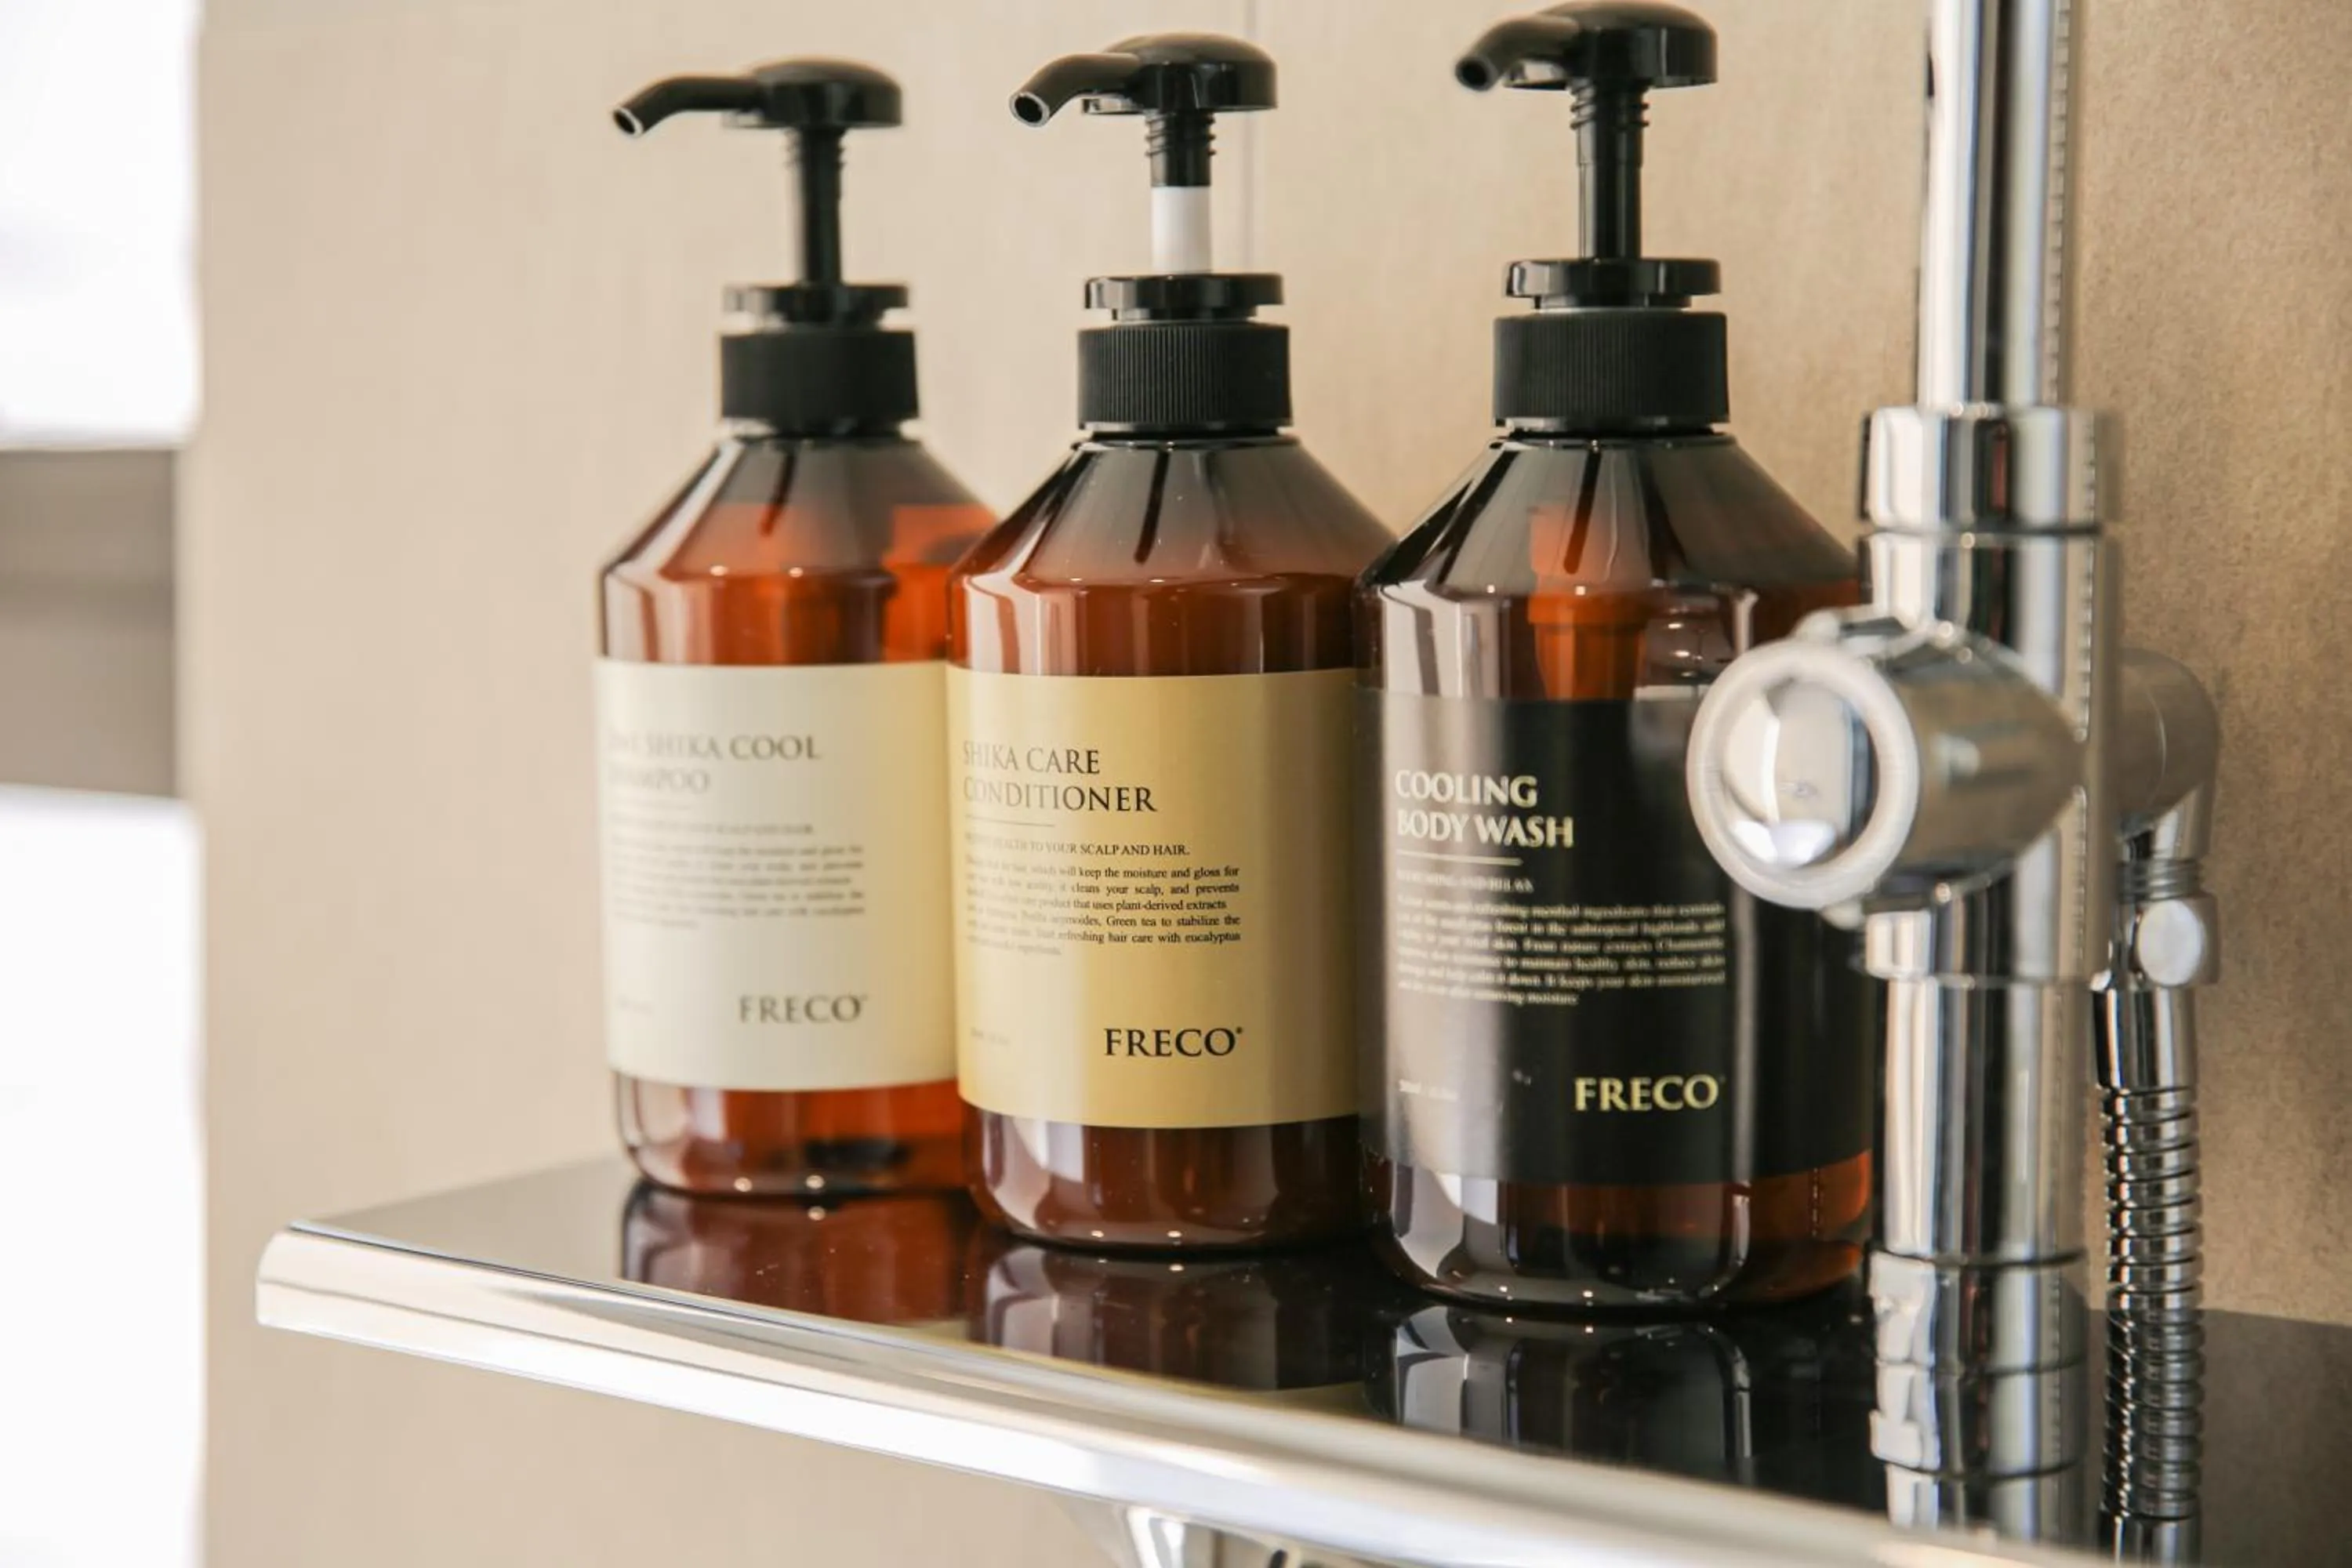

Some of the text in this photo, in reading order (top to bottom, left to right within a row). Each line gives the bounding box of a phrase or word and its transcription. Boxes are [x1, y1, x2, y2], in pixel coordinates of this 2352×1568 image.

[729, 734, 822, 760] COOL
[964, 740, 1100, 774] SHIKA CARE
[964, 776, 1158, 811] CONDITIONER
[1395, 769, 1538, 808] COOLING
[1396, 808, 1574, 848] BODY WASH
[1046, 840, 1077, 854] YOUR
[1080, 843, 1119, 855] SCALP
[1121, 844, 1150, 855] AND
[1153, 844, 1190, 855] HAIR.
[1079, 866, 1102, 880] keep
[1105, 867, 1120, 878] the
[1123, 867, 1167, 878] moisture
[1171, 867, 1190, 878] and
[1193, 866, 1221, 880] gloss
[1224, 865, 1240, 877] for
[1106, 885, 1129, 897] your
[1134, 884, 1164, 897] scalp,
[1170, 884, 1189, 894] and
[1196, 884, 1240, 897] prevents
[1073, 898, 1091, 909] that
[1092, 901, 1114, 910] uses
[1116, 900, 1183, 913] plant-derived
[1185, 900, 1228, 910] extracts
[1106, 915, 1137, 927] Green
[1141, 916, 1156, 927] tea
[1161, 917, 1172, 927] to
[1177, 915, 1220, 927] stabilize
[1224, 914, 1241, 926] the
[1109, 931, 1127, 942] hair
[1131, 934, 1153, 943] care
[1158, 932, 1181, 943] with
[1185, 931, 1241, 945] eucalyptus
[739, 993, 862, 1024] FRECO
[1104, 1028, 1236, 1057] FRECO
[1574, 1075, 1719, 1111] FRECO
